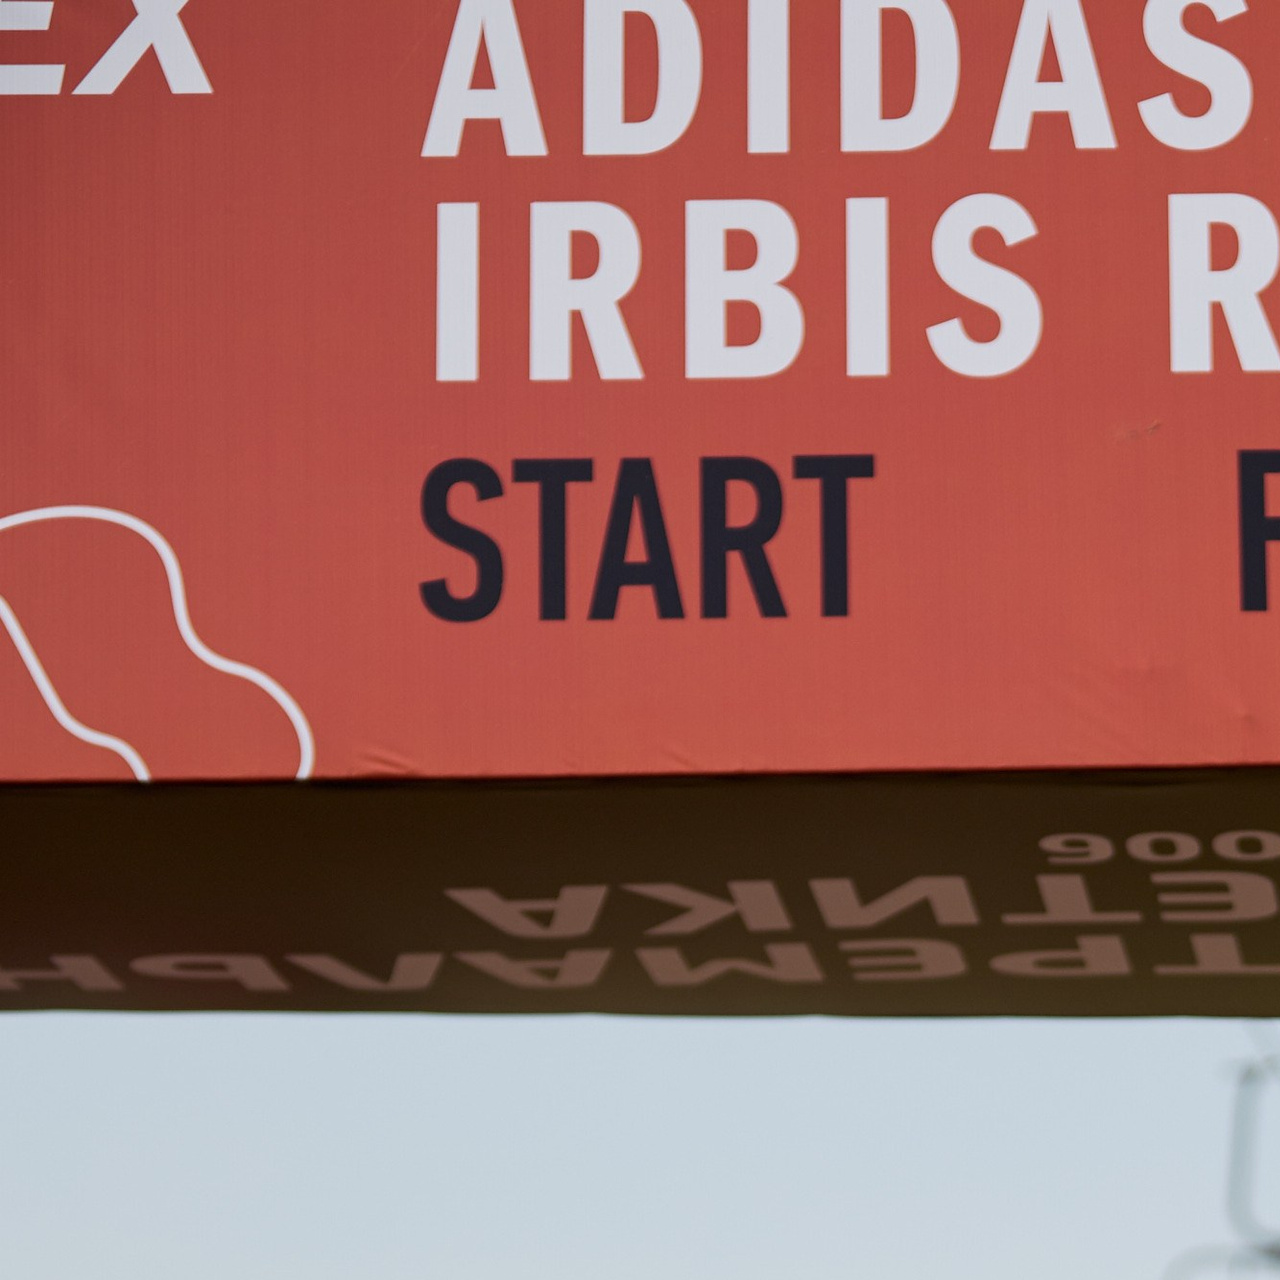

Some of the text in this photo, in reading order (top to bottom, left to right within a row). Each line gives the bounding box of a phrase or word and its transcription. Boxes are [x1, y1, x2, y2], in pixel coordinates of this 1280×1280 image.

[420, 0, 1254, 157] ADIDAS
[435, 193, 1044, 382] IRBIS
[418, 453, 876, 624] START
